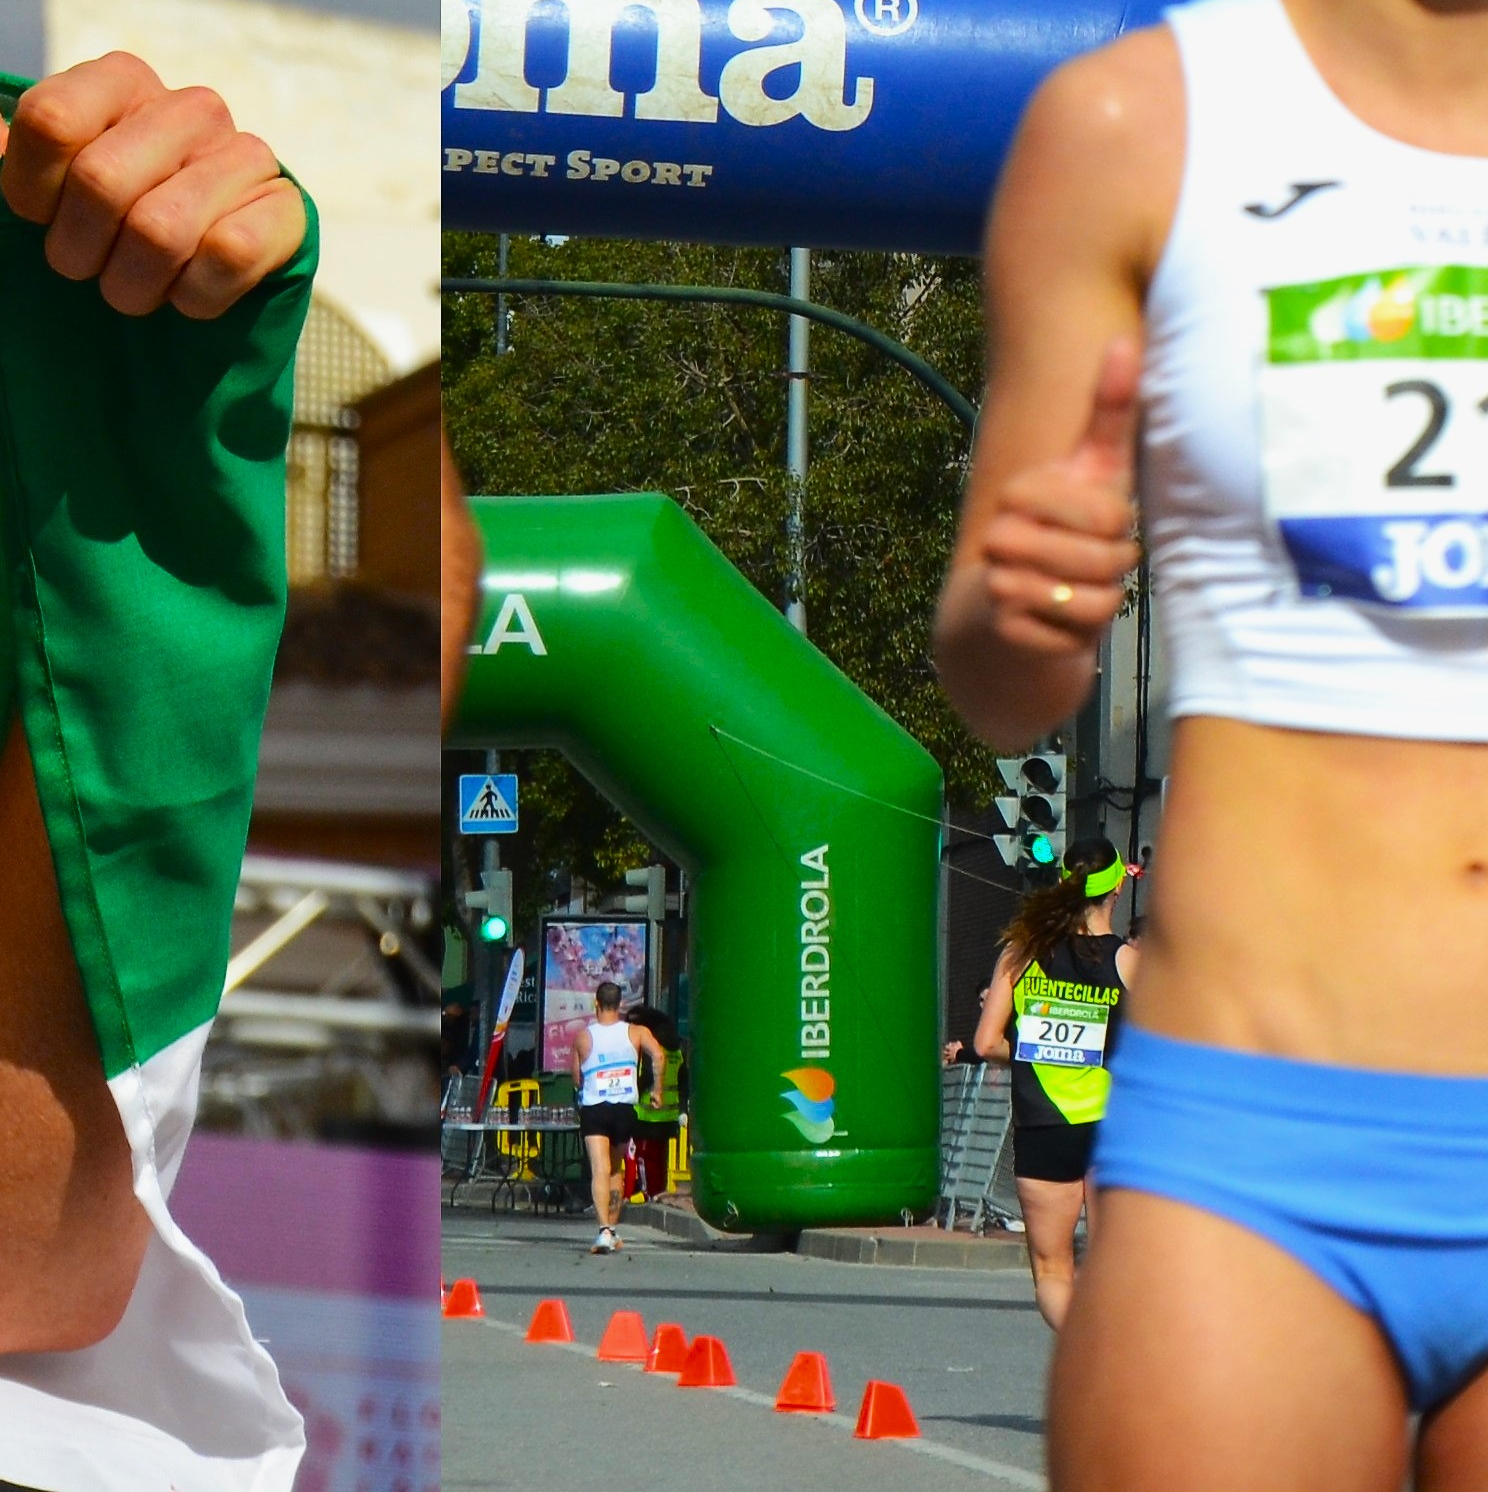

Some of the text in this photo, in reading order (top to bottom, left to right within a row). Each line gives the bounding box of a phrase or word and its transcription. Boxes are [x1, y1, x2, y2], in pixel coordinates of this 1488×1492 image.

[468, 592, 549, 656] A
[800, 843, 831, 1059] IBERDROLA
[1024, 976, 1120, 1006] PUENTECILLAS
[1049, 1006, 1100, 1020] IBERDROLA
[1038, 1020, 1086, 1045] 207
